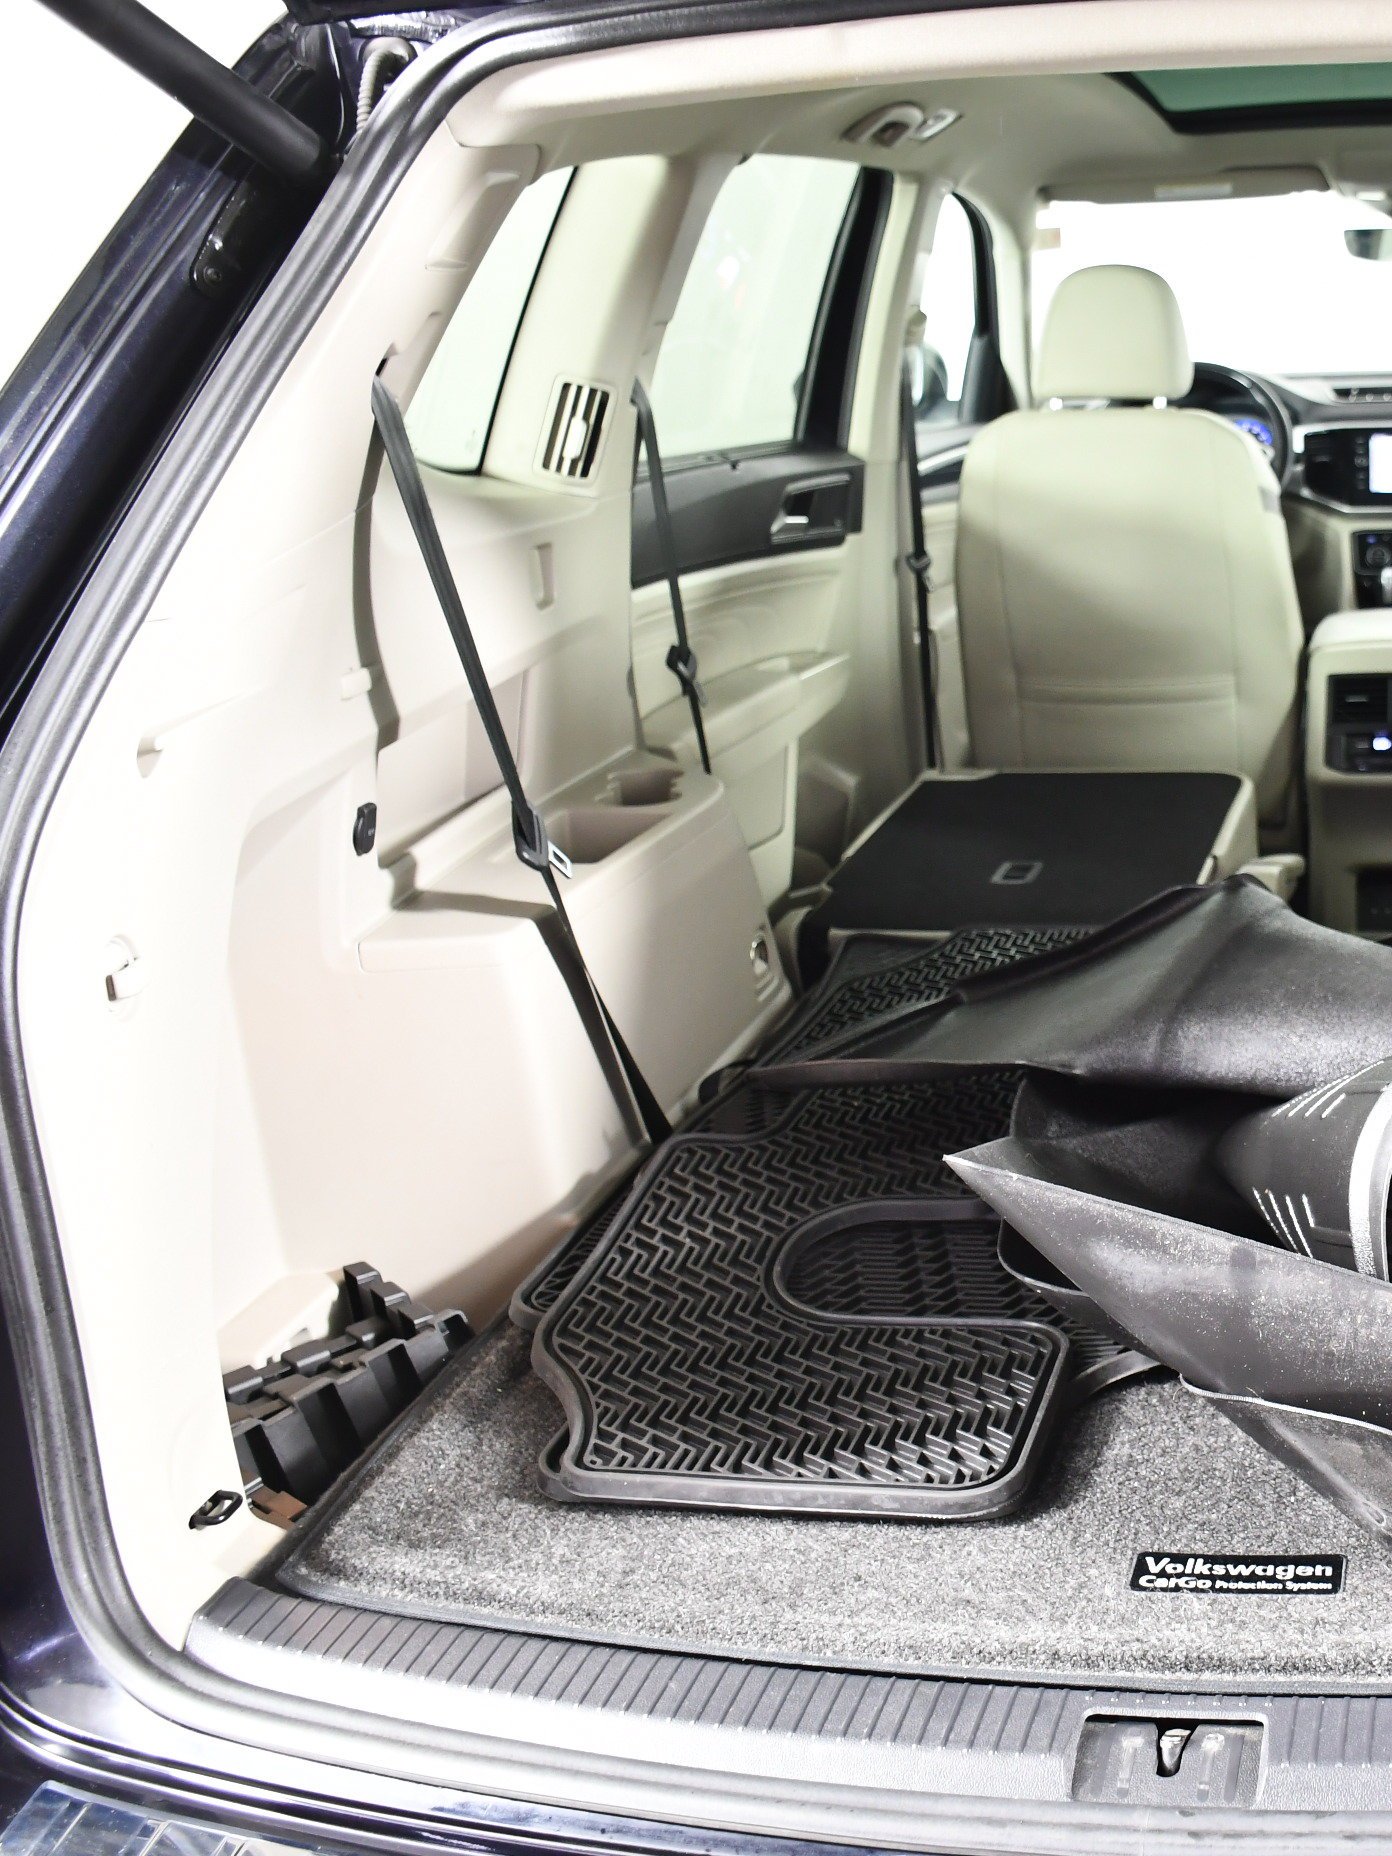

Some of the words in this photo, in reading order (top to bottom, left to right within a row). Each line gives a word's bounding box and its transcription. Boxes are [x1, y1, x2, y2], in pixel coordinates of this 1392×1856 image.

[1145, 1556, 1333, 1579] Volkswagen
[1215, 1580, 1283, 1590] Protection
[1285, 1581, 1333, 1591] System
